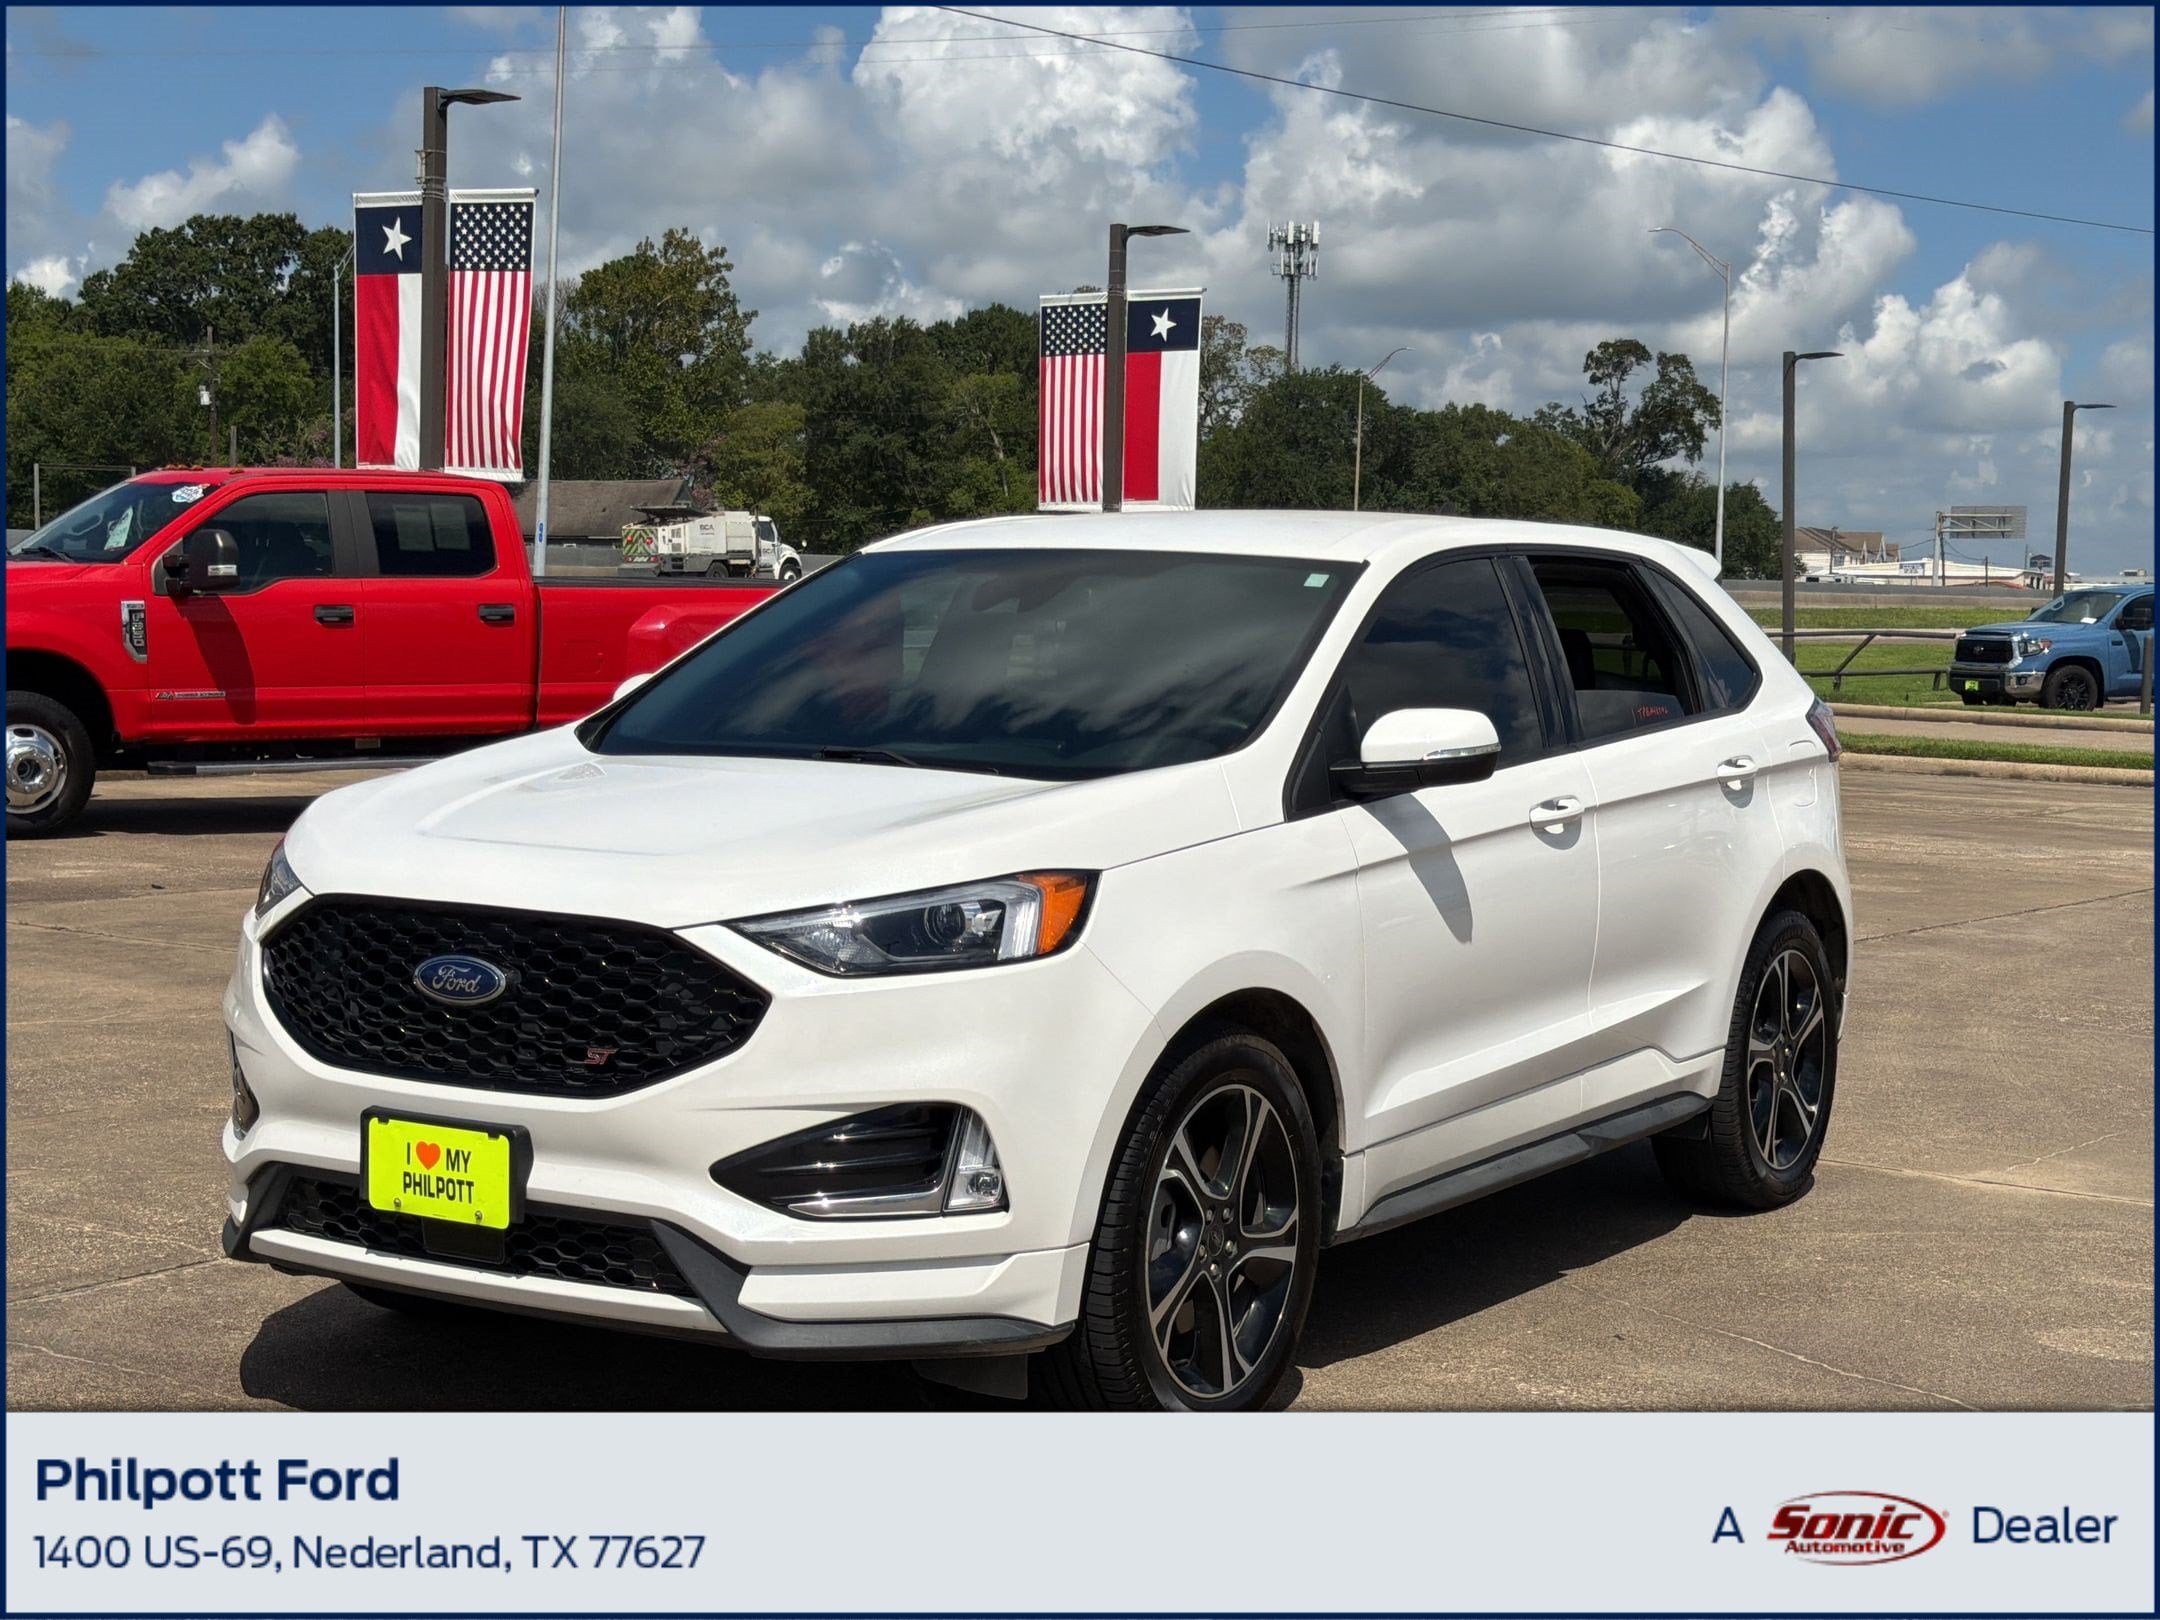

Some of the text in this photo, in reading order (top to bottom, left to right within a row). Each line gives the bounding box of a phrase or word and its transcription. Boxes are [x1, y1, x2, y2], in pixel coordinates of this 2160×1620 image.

[432, 964, 480, 993] Ford
[584, 1048, 617, 1065] ST
[406, 1142, 472, 1174] I MY
[402, 1171, 475, 1204] PHILPOTT
